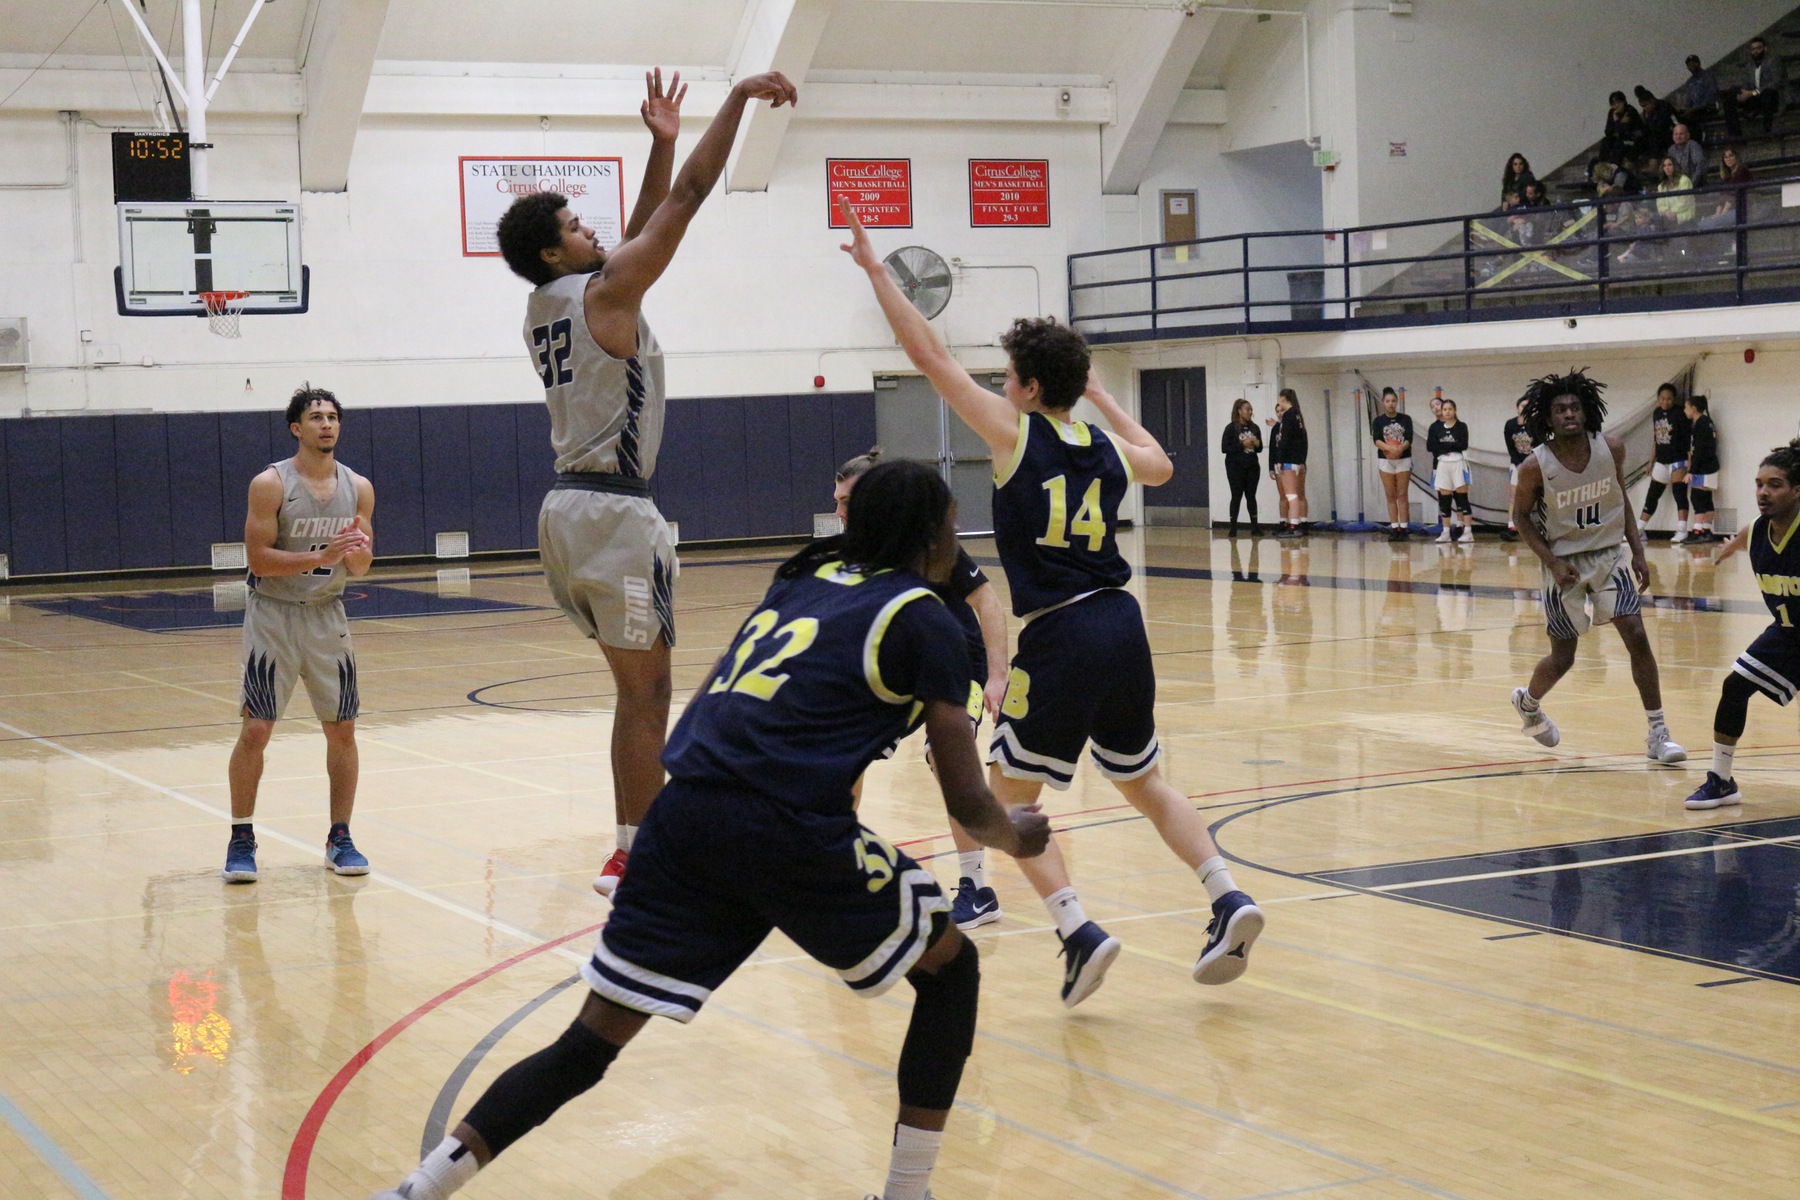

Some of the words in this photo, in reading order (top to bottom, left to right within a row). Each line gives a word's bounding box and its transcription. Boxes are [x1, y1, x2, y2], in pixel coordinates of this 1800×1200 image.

[130, 138, 183, 159] 10:52
[471, 164, 518, 177] STATE
[521, 164, 611, 177] CHAMPIONS
[860, 192, 880, 201] 2009
[1000, 192, 1020, 201] 2010
[532, 317, 573, 389] 32
[1556, 477, 1611, 510] CITRUS
[1035, 474, 1106, 552] 14
[1576, 501, 1602, 530] 14
[623, 575, 649, 644] OWLS
[1776, 603, 1794, 628] 1
[707, 609, 819, 701] 32
[1001, 666, 1031, 720] B
